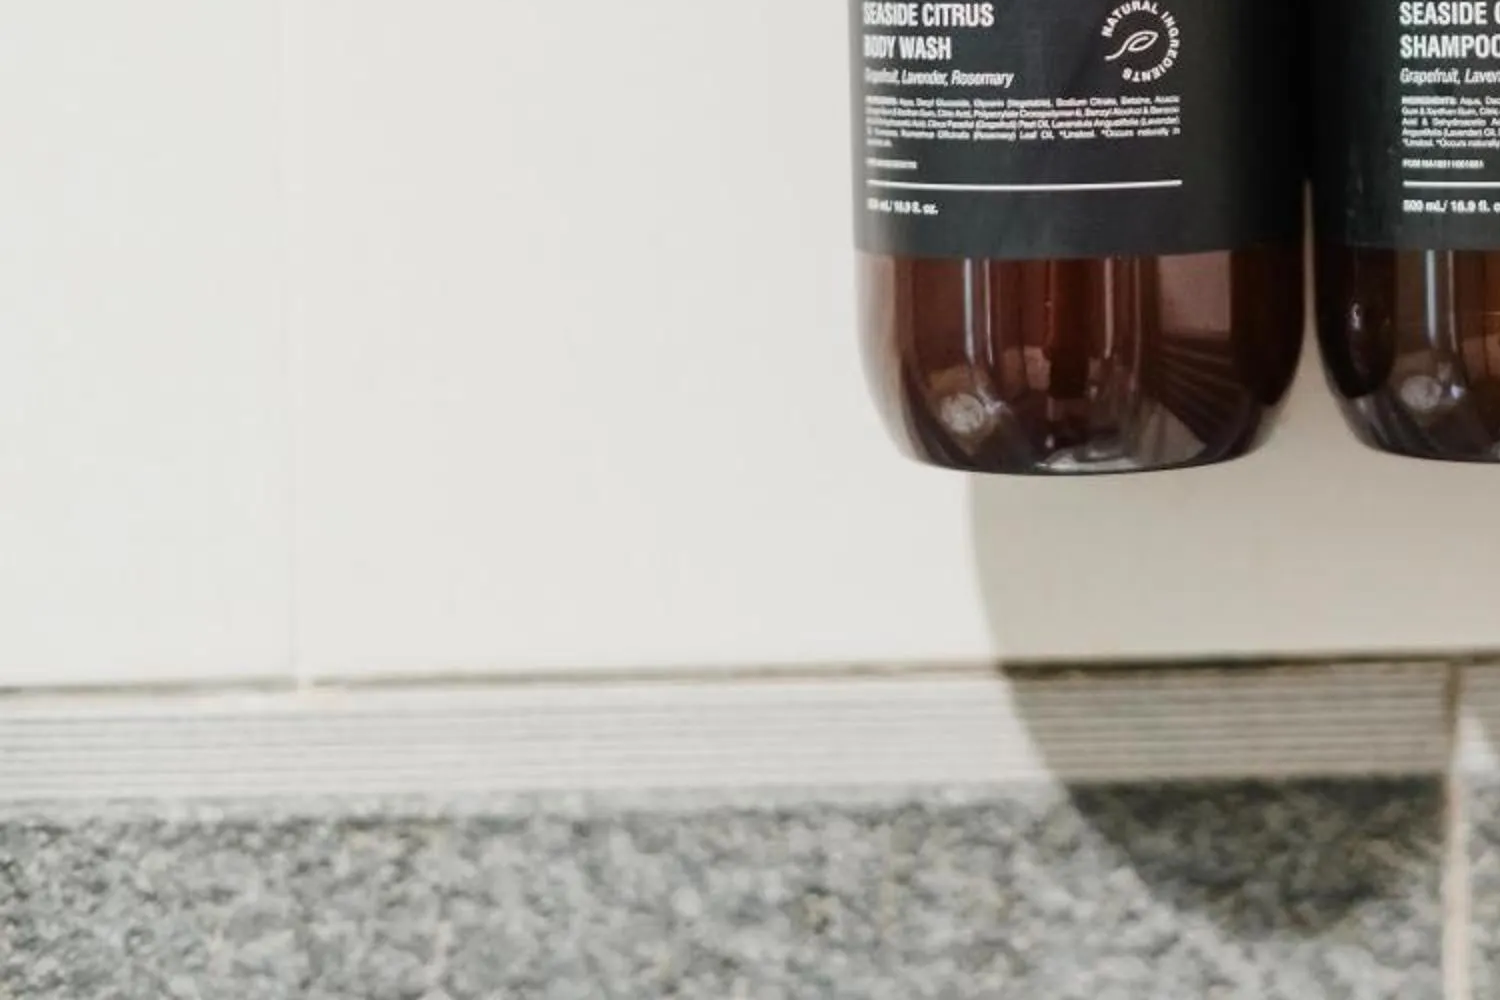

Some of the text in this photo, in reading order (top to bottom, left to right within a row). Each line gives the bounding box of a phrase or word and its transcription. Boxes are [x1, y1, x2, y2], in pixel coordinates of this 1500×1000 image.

[863, 1, 995, 27] SEASIDE CITRUS
[1101, 0, 1158, 38] NATURAL
[1400, 1, 1487, 26] SEASIDE
[864, 34, 952, 60] BODY WASH
[1122, 11, 1180, 82] INGREDIENTS
[951, 69, 1014, 88] Rosemary
[1400, 67, 1461, 86] Grapefruit,
[1451, 200, 1476, 213] 16.9
